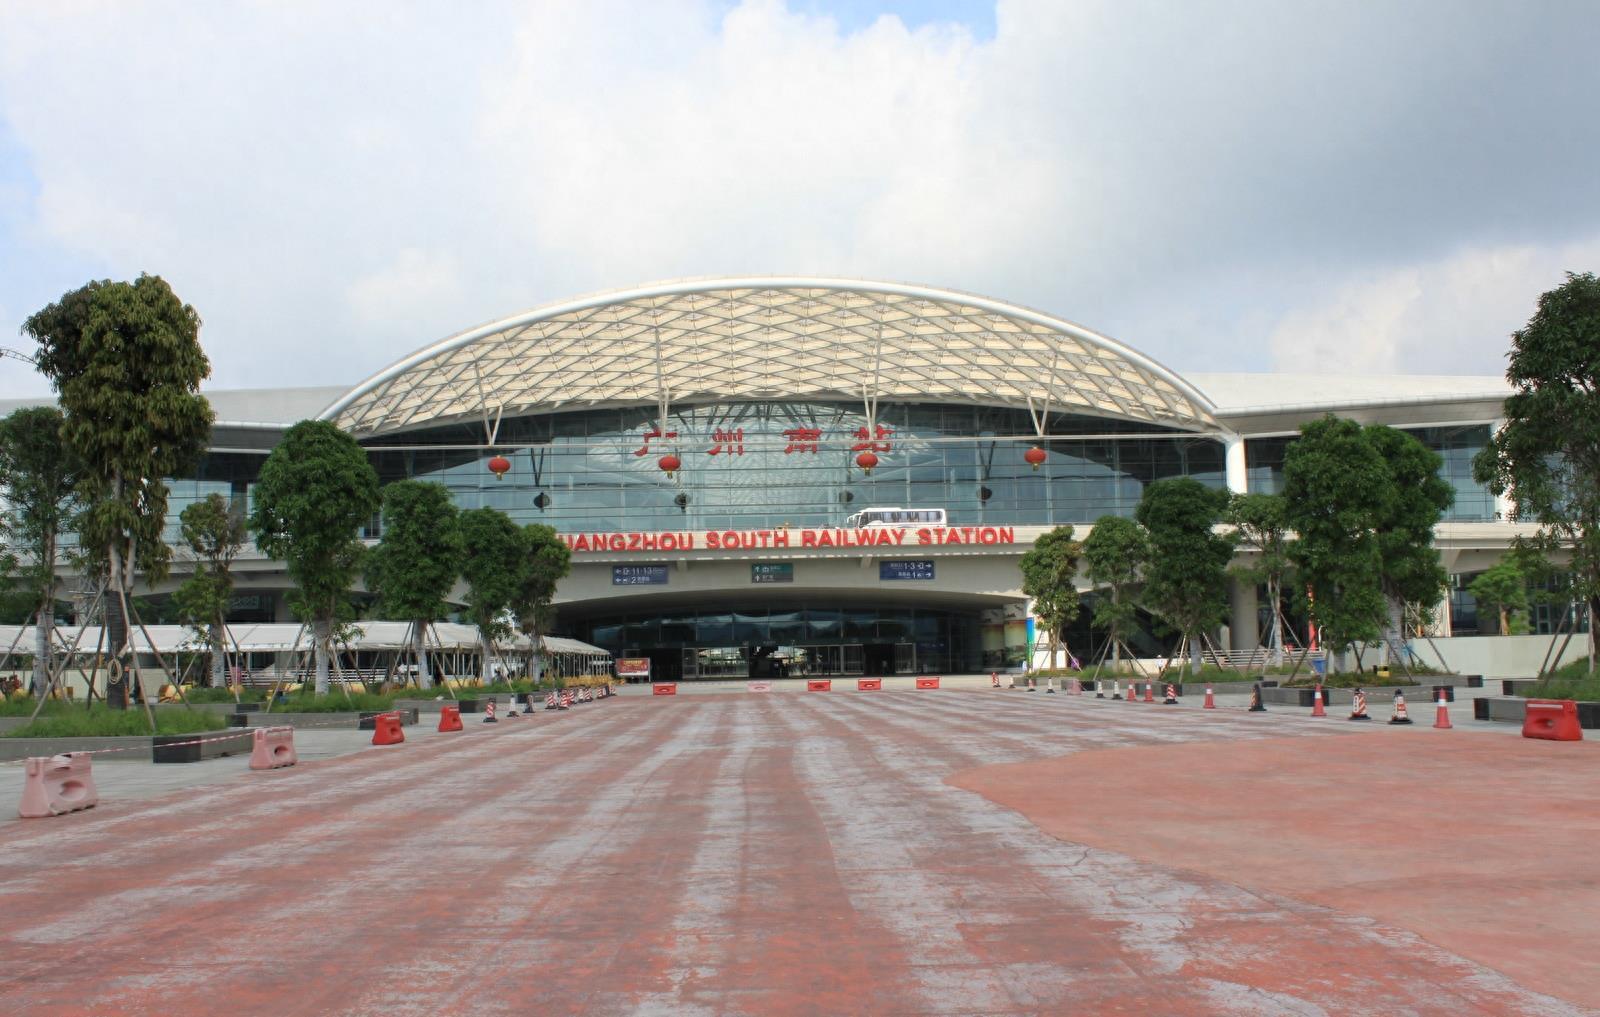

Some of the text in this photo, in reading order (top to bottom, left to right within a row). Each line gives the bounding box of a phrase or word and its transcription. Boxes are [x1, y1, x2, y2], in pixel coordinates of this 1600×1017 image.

[634, 425, 895, 456] 广州南站
[558, 526, 1015, 551] UANGZHOU SOUTH RAILWAY STATION
